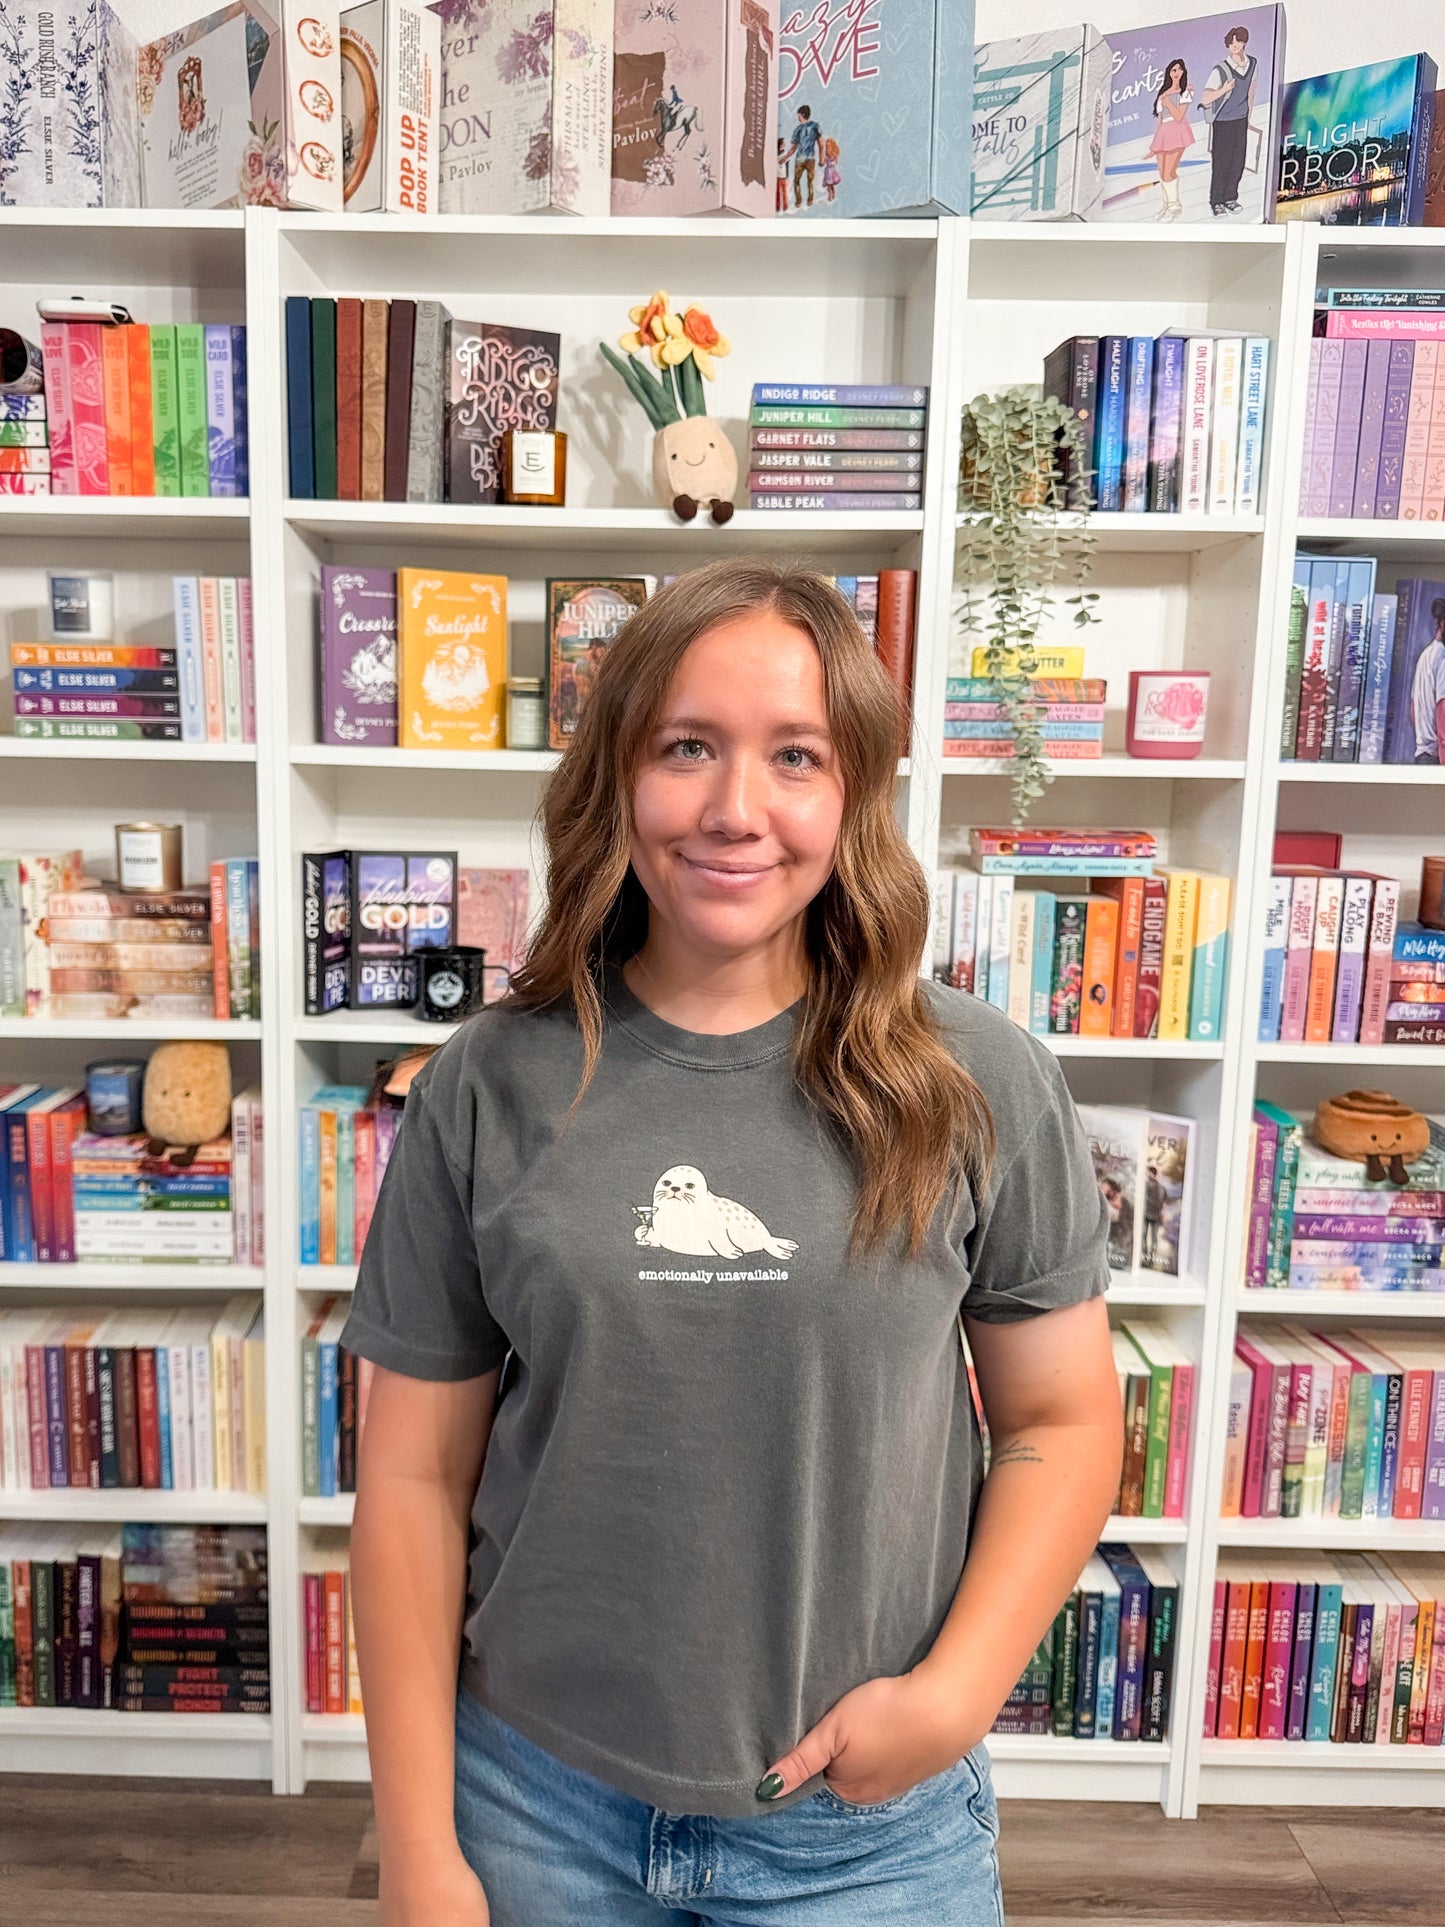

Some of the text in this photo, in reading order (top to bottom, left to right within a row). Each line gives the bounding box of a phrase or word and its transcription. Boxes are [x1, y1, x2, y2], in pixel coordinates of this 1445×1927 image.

[38, 12, 56, 99] GOLD RUSH RANCH
[614, 127, 657, 148] Pavlov
[756, 99, 764, 149] HORSE
[1006, 116, 1026, 133] TO
[44, 116, 56, 185] ELSIE SILVER
[400, 114, 414, 209] POP UP
[417, 118, 428, 214] BOOK TENT
[449, 159, 492, 181] Pavlov
[1281, 143, 1384, 190] RBOR
[1340, 293, 1353, 303] Into
[1362, 294, 1383, 305] Fading
[1384, 293, 1408, 306] Twilight
[1396, 320, 1437, 332] Vanishing
[44, 337, 62, 347] WILD
[45, 349, 63, 359] LOVE
[152, 338, 171, 348] WILD
[152, 350, 170, 361] SIDE
[208, 340, 228, 350] WILD
[208, 351, 229, 361] CARD
[456, 336, 558, 390] INDIGO
[1109, 340, 1121, 394] HALF-LIGHT
[1136, 341, 1147, 385] DRIFTING
[1165, 343, 1175, 387] TWILIGHT
[51, 368, 62, 415] ELSIE SILVER
[159, 370, 168, 416] ELSIE SILVER
[215, 370, 225, 418] ELSIE SILVER
[762, 388, 837, 400] INDIGO RIDGE
[1193, 346, 1207, 430] ON LOVEROSE LANE
[1246, 346, 1263, 428] HART STREET LANE
[458, 381, 552, 430] RIDGE
[759, 412, 832, 423] JUNIPER HILL
[757, 433, 836, 445] GARNET FLATS
[526, 452, 540, 467] E
[759, 455, 800, 466] JASPER
[803, 456, 831, 466] VALE
[1190, 438, 1200, 494] SAMANTHA YOUNG
[1244, 439, 1252, 473] SAMANTHA
[758, 475, 834, 486] CRIMSON RIVER
[757, 497, 825, 509] SABLE PEAK
[424, 613, 489, 641] Sunlight
[1287, 608, 1303, 641] simple
[1315, 600, 1328, 623] wild
[1347, 603, 1363, 641] running
[1381, 604, 1390, 632] PRETTY
[182, 613, 193, 644] SILVER
[1314, 626, 1324, 636] at
[54, 650, 113, 663] ELSIE SILVER
[1378, 634, 1387, 657] LITTLE
[58, 674, 116, 686] ELSIE SILVER
[59, 700, 118, 712] ELSIE SILVER
[59, 724, 118, 737] ELSIE SILVER
[134, 903, 206, 914] ELSIE SILVER
[1178, 879, 1188, 909] PLEASE
[359, 904, 450, 930] GOLD
[1265, 908, 1274, 937] HIGH
[1274, 899, 1285, 926] MILE
[1292, 900, 1303, 934] MOVE
[1300, 906, 1311, 941] RIGHT
[1319, 911, 1328, 929] UP
[1326, 896, 1338, 944] CAUGHT
[1344, 901, 1356, 944] ALONG
[1355, 898, 1366, 928] PLAY
[1374, 912, 1384, 943] BACK
[1383, 899, 1394, 945] REWIND
[305, 897, 319, 1001] GOLD DEVNEY PERRY
[1140, 897, 1166, 976] ENDGAME
[1403, 939, 1426, 956] Mile
[1258, 1141, 1274, 1204] ONE ONLY
[1315, 1169, 1339, 1185] play
[1309, 1219, 1332, 1236] fall
[1331, 1220, 1355, 1235] with
[1359, 1225, 1377, 1233] me
[639, 1269, 789, 1283] emotionally unavailable
[1227, 1402, 1241, 1439] Resist
[1313, 1408, 1327, 1443] ZONE
[1385, 1378, 1401, 1450] ON THIN ICE
[1408, 1378, 1423, 1443] ELLE KENNEDY
[1434, 1400, 1445, 1444] KENNEDY
[1128, 1593, 1142, 1628] PIECES
[1212, 1608, 1224, 1641] CHLOE
[1235, 1608, 1246, 1641] CHLOE
[1256, 1608, 1267, 1641] CHLOE
[1271, 1609, 1281, 1643] WALSH
[1279, 1609, 1291, 1643] CHLOE
[1302, 1611, 1313, 1641] CHLOE
[1325, 1609, 1338, 1643] CHLOE
[1296, 1612, 1305, 1641] WALSH
[1318, 1610, 1328, 1643] WALSH
[1354, 1618, 1371, 1676] Take My Name
[1153, 1670, 1165, 1695] EMMA
[1399, 1671, 1411, 1687] OFF
[1149, 1695, 1164, 1724] SCOTT
